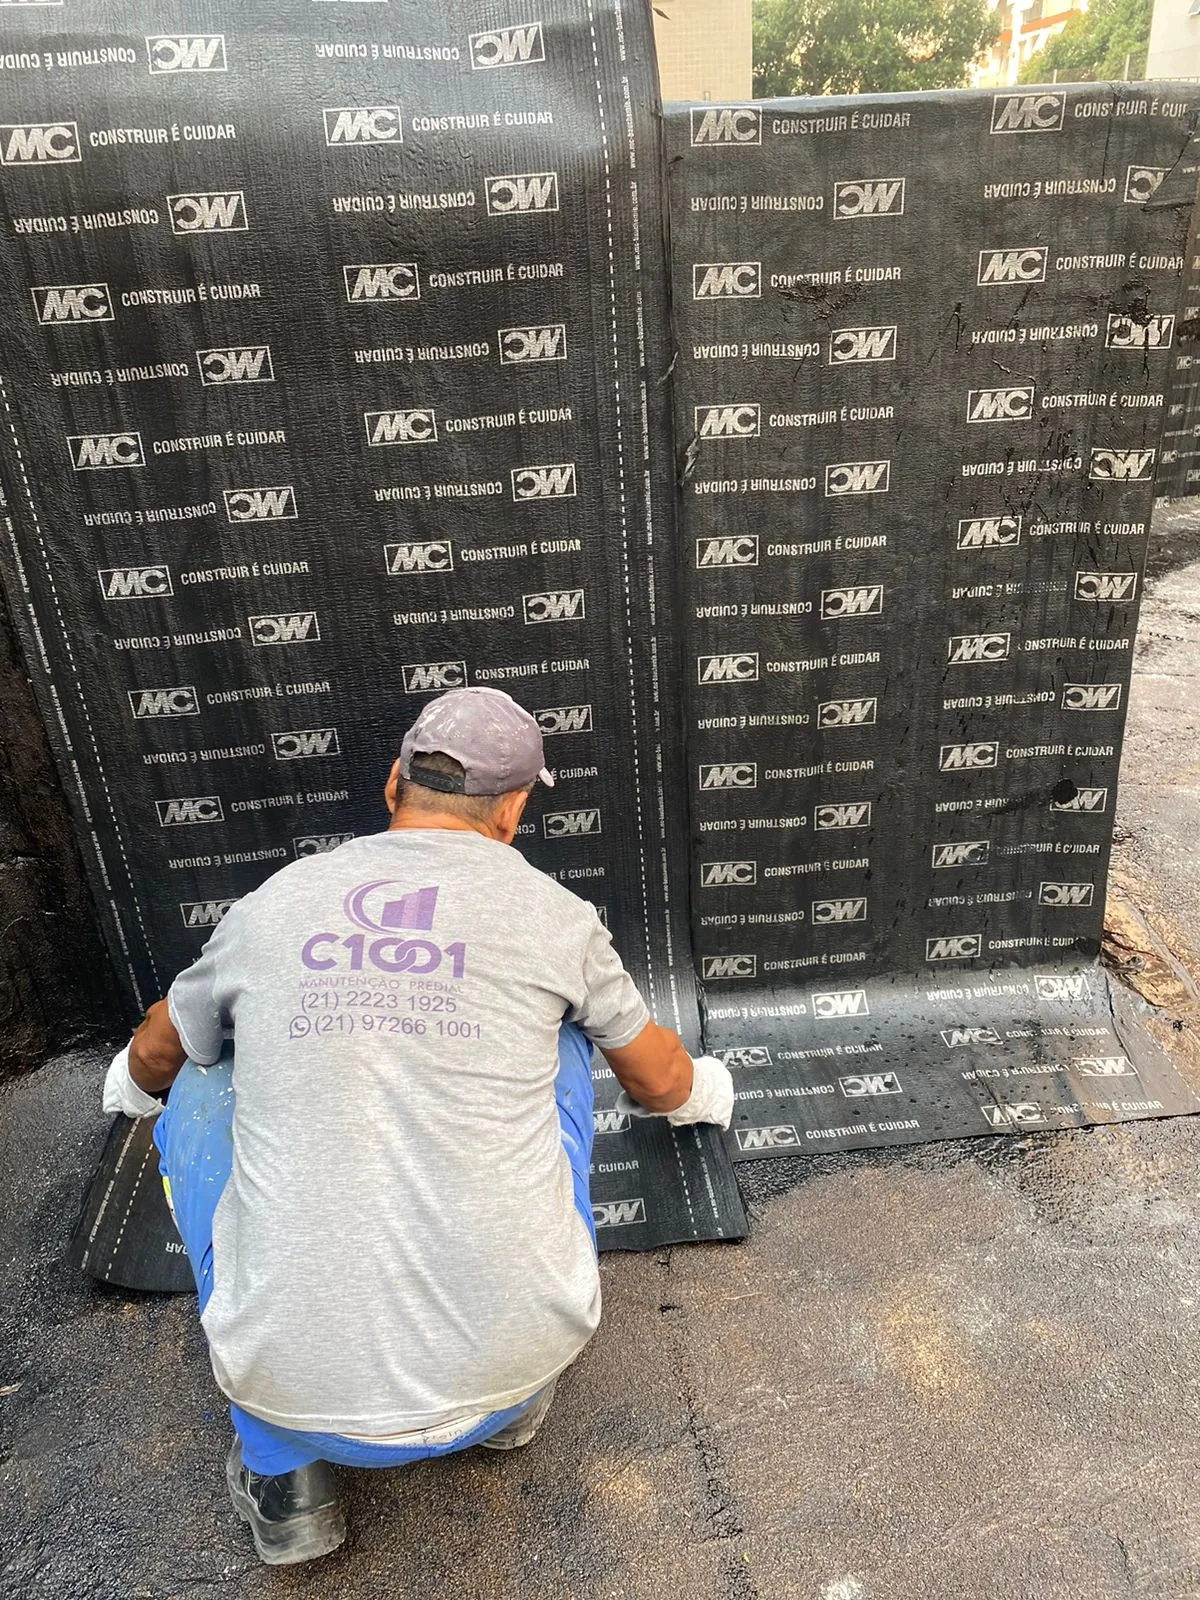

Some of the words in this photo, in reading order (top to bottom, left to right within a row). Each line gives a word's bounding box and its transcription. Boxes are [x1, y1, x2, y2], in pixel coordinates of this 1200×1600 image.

[315, 44, 367, 57] CUIDAR
[371, 44, 379, 60] É
[382, 45, 459, 60] CONSTRUIR
[476, 28, 539, 64] MC
[331, 110, 397, 141] MC
[412, 115, 489, 131] CONSTRUIR
[493, 111, 501, 126] É
[505, 111, 553, 125] CUIDAR
[6, 127, 75, 160] MC
[90, 129, 168, 146] CONSTRUIR
[171, 124, 180, 141] É
[184, 124, 236, 140] CUIDAR
[491, 177, 553, 211] MC
[839, 182, 901, 215] MC
[984, 183, 1030, 198] CUIDAR
[1033, 182, 1041, 198] É
[333, 196, 383, 212] CUIDAR
[387, 195, 395, 212] É
[399, 190, 475, 209] CONSTRUIR
[691, 196, 737, 211] CUIDAR
[741, 196, 747, 213] É
[752, 196, 823, 210] CONSTRUIR
[82, 209, 159, 229] CONSTRUIR
[174, 196, 239, 229] MC
[13, 217, 67, 233] CUIDAR
[70, 216, 79, 233] É
[981, 251, 1042, 281] MC
[1056, 254, 1125, 270] CONSTRUIR
[1129, 252, 1136, 267] É
[1139, 256, 1183, 269] CUIDAR
[352, 267, 415, 298] MC
[429, 269, 503, 287] CONSTRUIR
[507, 263, 515, 280] É
[518, 263, 563, 279] CUIDAR
[40, 287, 108, 320] MC
[122, 289, 196, 306] CONSTRUIR
[198, 283, 207, 300] É
[210, 284, 261, 299] CUIDAR
[418, 343, 489, 360] CONSTRUIR
[504, 329, 561, 360] MC
[354, 347, 403, 363] CUIDAR
[406, 348, 414, 363] É
[116, 363, 189, 381] CONSTRUIR
[203, 350, 265, 381] MC
[50, 371, 102, 386] CUIDAR
[105, 370, 114, 385] É
[971, 390, 1029, 419] MC
[1042, 394, 1106, 408] CONSTRUIR
[1110, 392, 1117, 406] É
[1121, 395, 1163, 407] CUIDAR
[699, 408, 755, 435] MC
[769, 411, 836, 427] CONSTRUIR
[841, 406, 847, 421] É
[850, 406, 893, 420] CUIDAR
[76, 436, 140, 466] MC
[153, 435, 222, 454] CONSTRUIR
[226, 431, 234, 446] É
[237, 431, 285, 445] CUIDAR
[517, 468, 572, 497] MC
[695, 480, 737, 494] CUIDAR
[741, 480, 747, 493] É
[751, 477, 816, 491] CONSTRUIR
[830, 464, 886, 492] MC
[374, 487, 421, 501] CUIDAR
[424, 486, 431, 500] É
[434, 482, 502, 497] CONSTRUIR
[146, 502, 216, 522] CONSTRUIR
[229, 490, 289, 518] MC
[84, 511, 132, 525] CUIDAR
[135, 511, 143, 522] É
[961, 519, 1016, 546] MC
[1104, 524, 1144, 534] CUIDAR
[392, 544, 448, 571] MC
[461, 544, 527, 561] CONSTRUIR
[531, 541, 538, 554] É
[540, 539, 581, 553] CUIDAR
[700, 538, 754, 564] MC
[768, 540, 831, 556] CONSTRUIR
[835, 536, 842, 549] É
[845, 535, 886, 549] CUIDAR
[107, 568, 168, 596] MC
[181, 566, 249, 585] CONSTRUIR
[252, 562, 260, 576] É
[263, 562, 309, 575] CUIDAR
[528, 593, 580, 621] MC
[741, 605, 747, 617] É
[751, 602, 812, 615] CONSTRUIR
[826, 589, 879, 615] MC
[393, 612, 437, 625] CUIDAR
[440, 610, 447, 623] É
[450, 606, 514, 620] CONSTRUIR
[696, 605, 738, 618] CUIDAR
[173, 627, 241, 645] CONSTRUIR
[255, 615, 313, 642] MC
[114, 637, 160, 649] CUIDAR
[163, 636, 170, 649] É
[953, 636, 1005, 660] MC
[1079, 637, 1086, 649] É
[1089, 639, 1129, 650] CUIDAR
[701, 655, 754, 681] MC
[767, 658, 828, 672] CONSTRUIR
[831, 655, 837, 666] É
[840, 652, 880, 665] CUIDAR
[136, 689, 194, 715] MC
[207, 687, 272, 704] CONSTRUIR
[276, 683, 283, 696] É
[286, 682, 330, 695] CUIDAR
[943, 697, 982, 709] CUIDAR
[1066, 687, 1117, 707] MC
[538, 708, 588, 734] MC
[740, 716, 746, 728] É
[749, 715, 809, 725] CONSTRUIR
[822, 701, 872, 725] MC
[698, 717, 737, 729] CUIDAR
[943, 745, 994, 768] MC
[1006, 745, 1065, 758] CONSTRUIR
[560, 767, 598, 779] CUIDAR
[548, 812, 596, 835] MC
[568, 867, 605, 879] CUIDAR
[301, 933, 466, 979] C1001
[706, 957, 753, 977] MC
[764, 956, 818, 970] CONSTRUIR
[822, 954, 827, 964] É
[830, 952, 865, 963] CUIDAR
[410, 981, 464, 993] PREDIAL
[302, 992, 339, 1013] (21)
[347, 991, 398, 1008] 2223
[408, 995, 456, 1013] 1925
[315, 1015, 354, 1036] (21)
[362, 1015, 426, 1035] 97266
[436, 1020, 480, 1040] 1001
[739, 1128, 796, 1147] MC
[806, 1125, 867, 1139] CONSTRUIR
[869, 1122, 877, 1132] É
[878, 1120, 920, 1131] CUIDAR
[599, 1160, 639, 1173] CUIDAR
